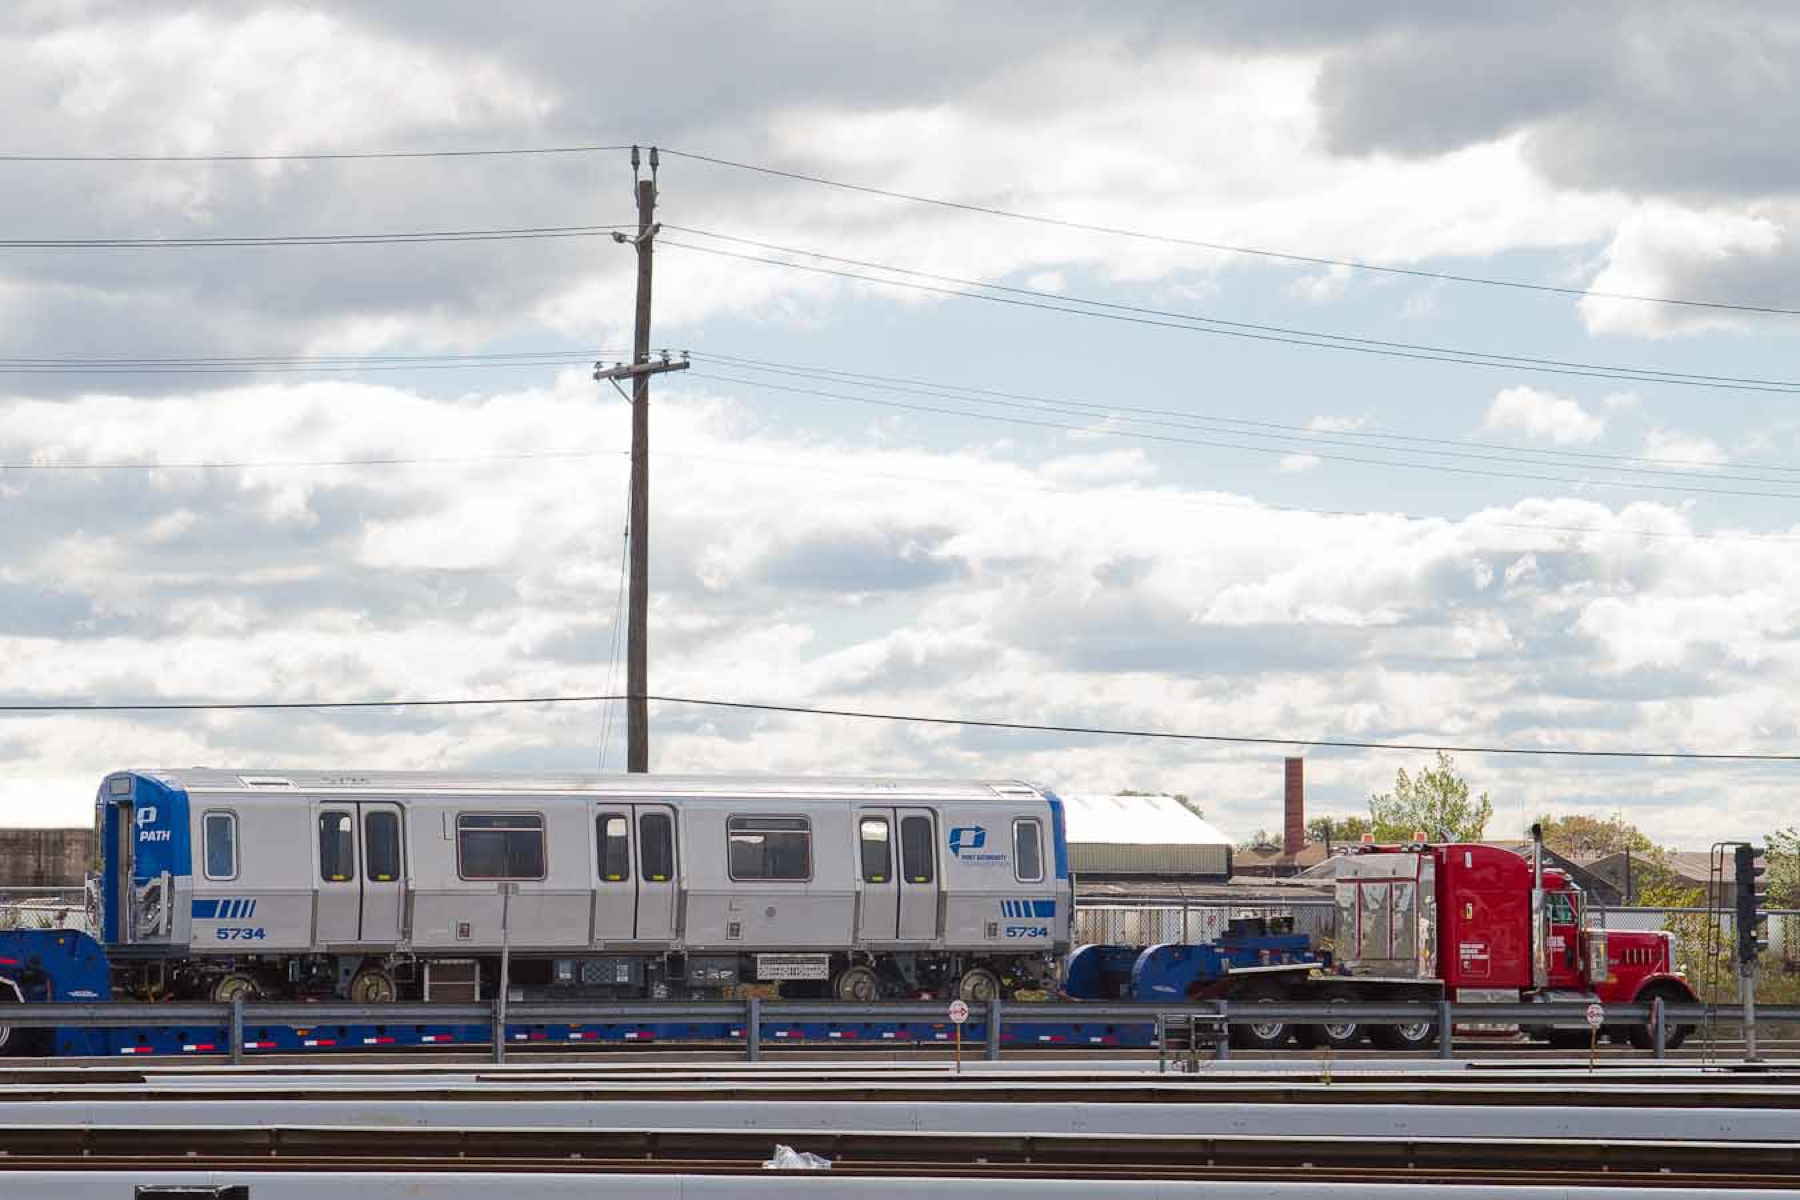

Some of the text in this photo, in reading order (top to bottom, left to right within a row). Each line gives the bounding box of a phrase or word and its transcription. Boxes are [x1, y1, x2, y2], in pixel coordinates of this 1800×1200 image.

[140, 831, 170, 841] PATH
[216, 927, 266, 940] 5734
[1006, 927, 1048, 938] 5734
